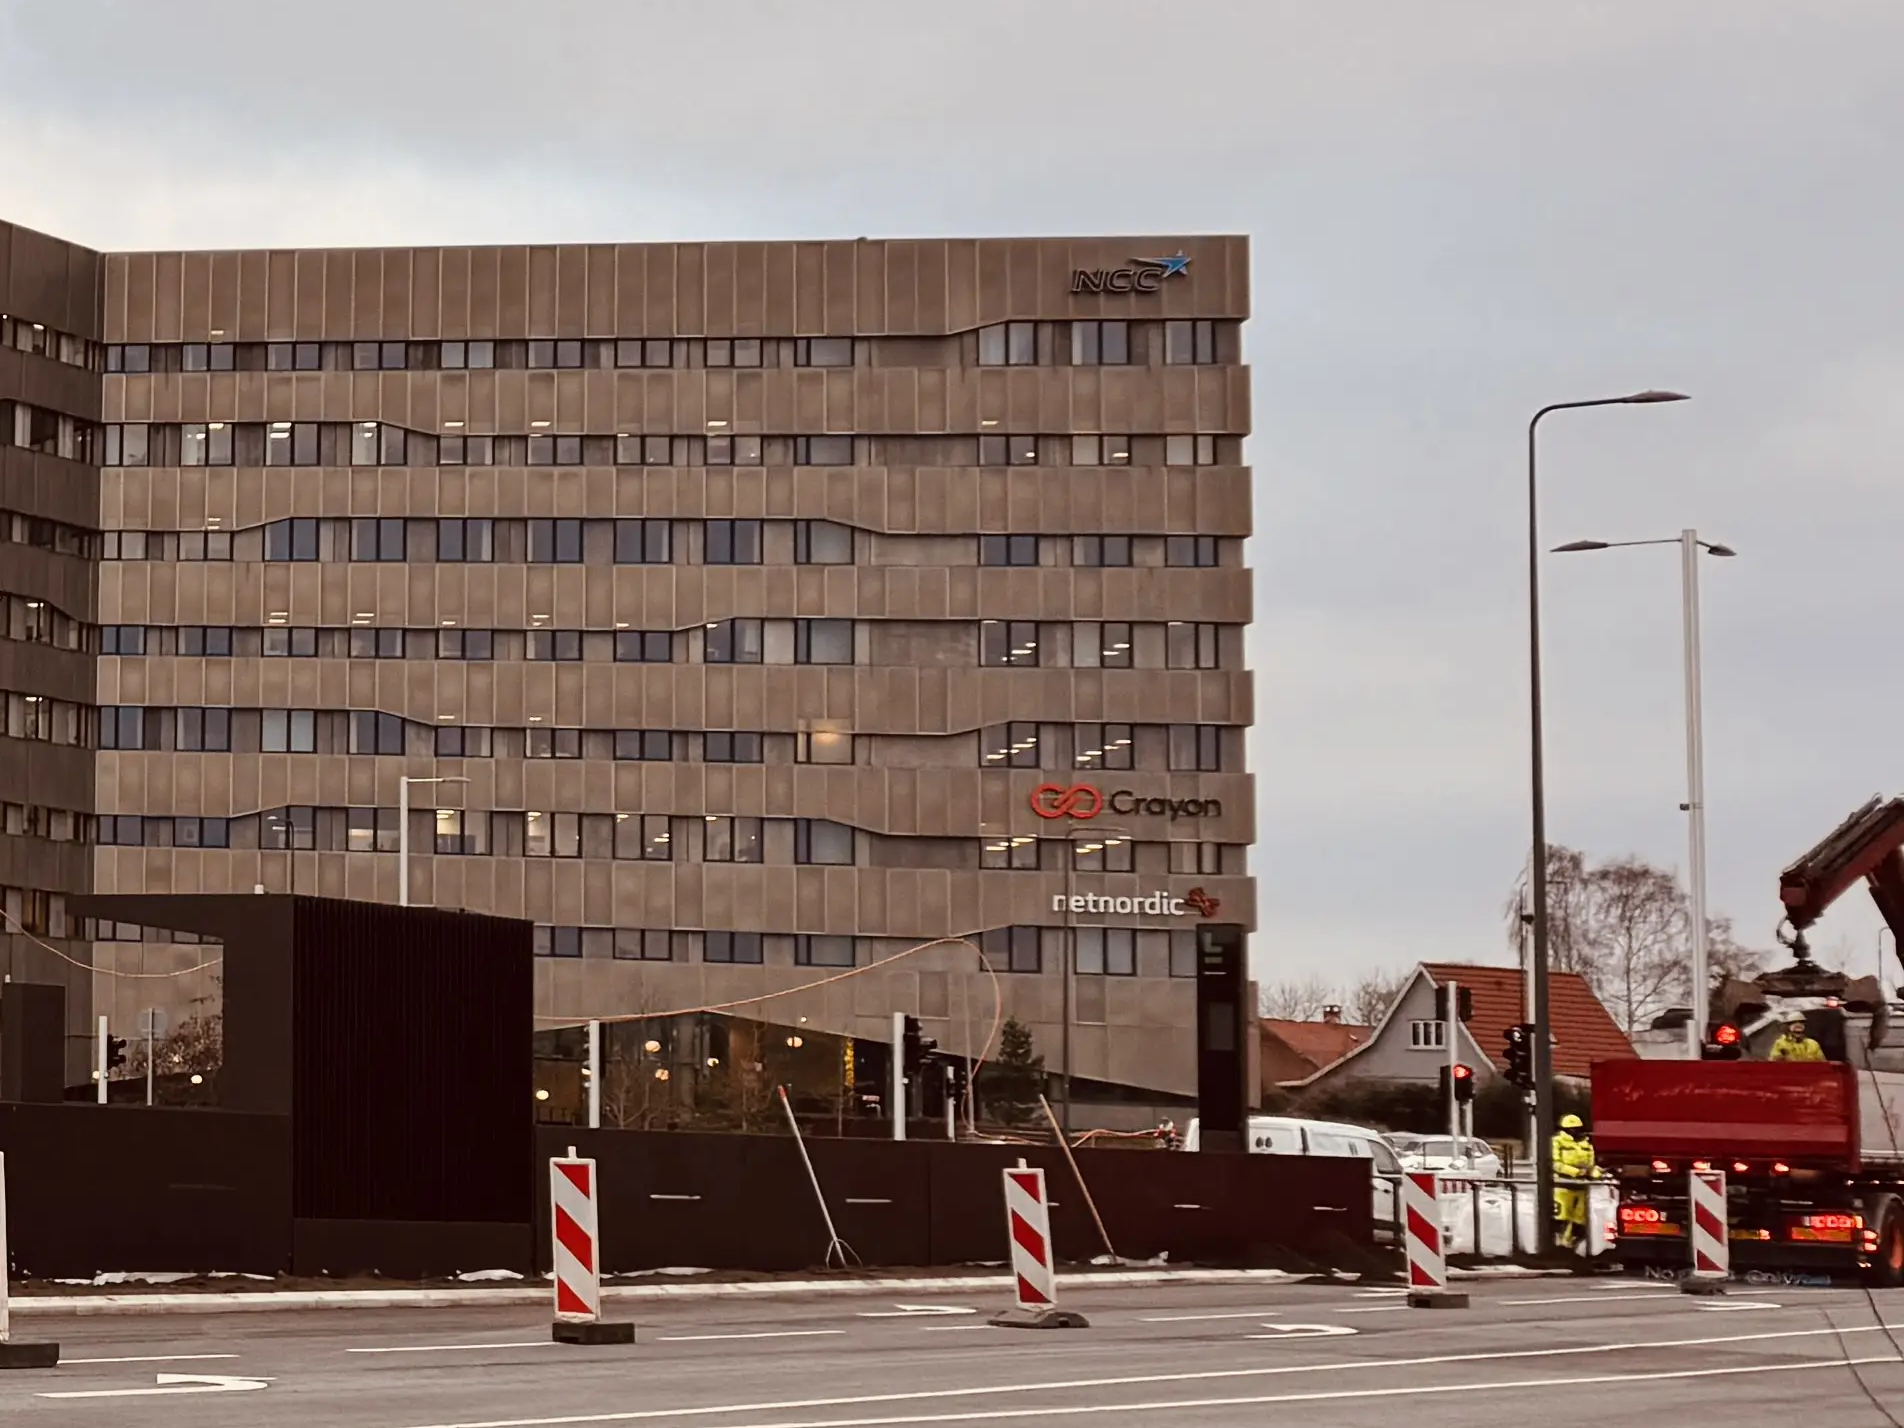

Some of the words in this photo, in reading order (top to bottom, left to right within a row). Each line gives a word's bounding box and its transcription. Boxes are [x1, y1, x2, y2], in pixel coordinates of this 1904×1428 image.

[1069, 267, 1163, 294] NCC
[1109, 790, 1221, 820] Crayon
[1052, 891, 1185, 916] netnordic
